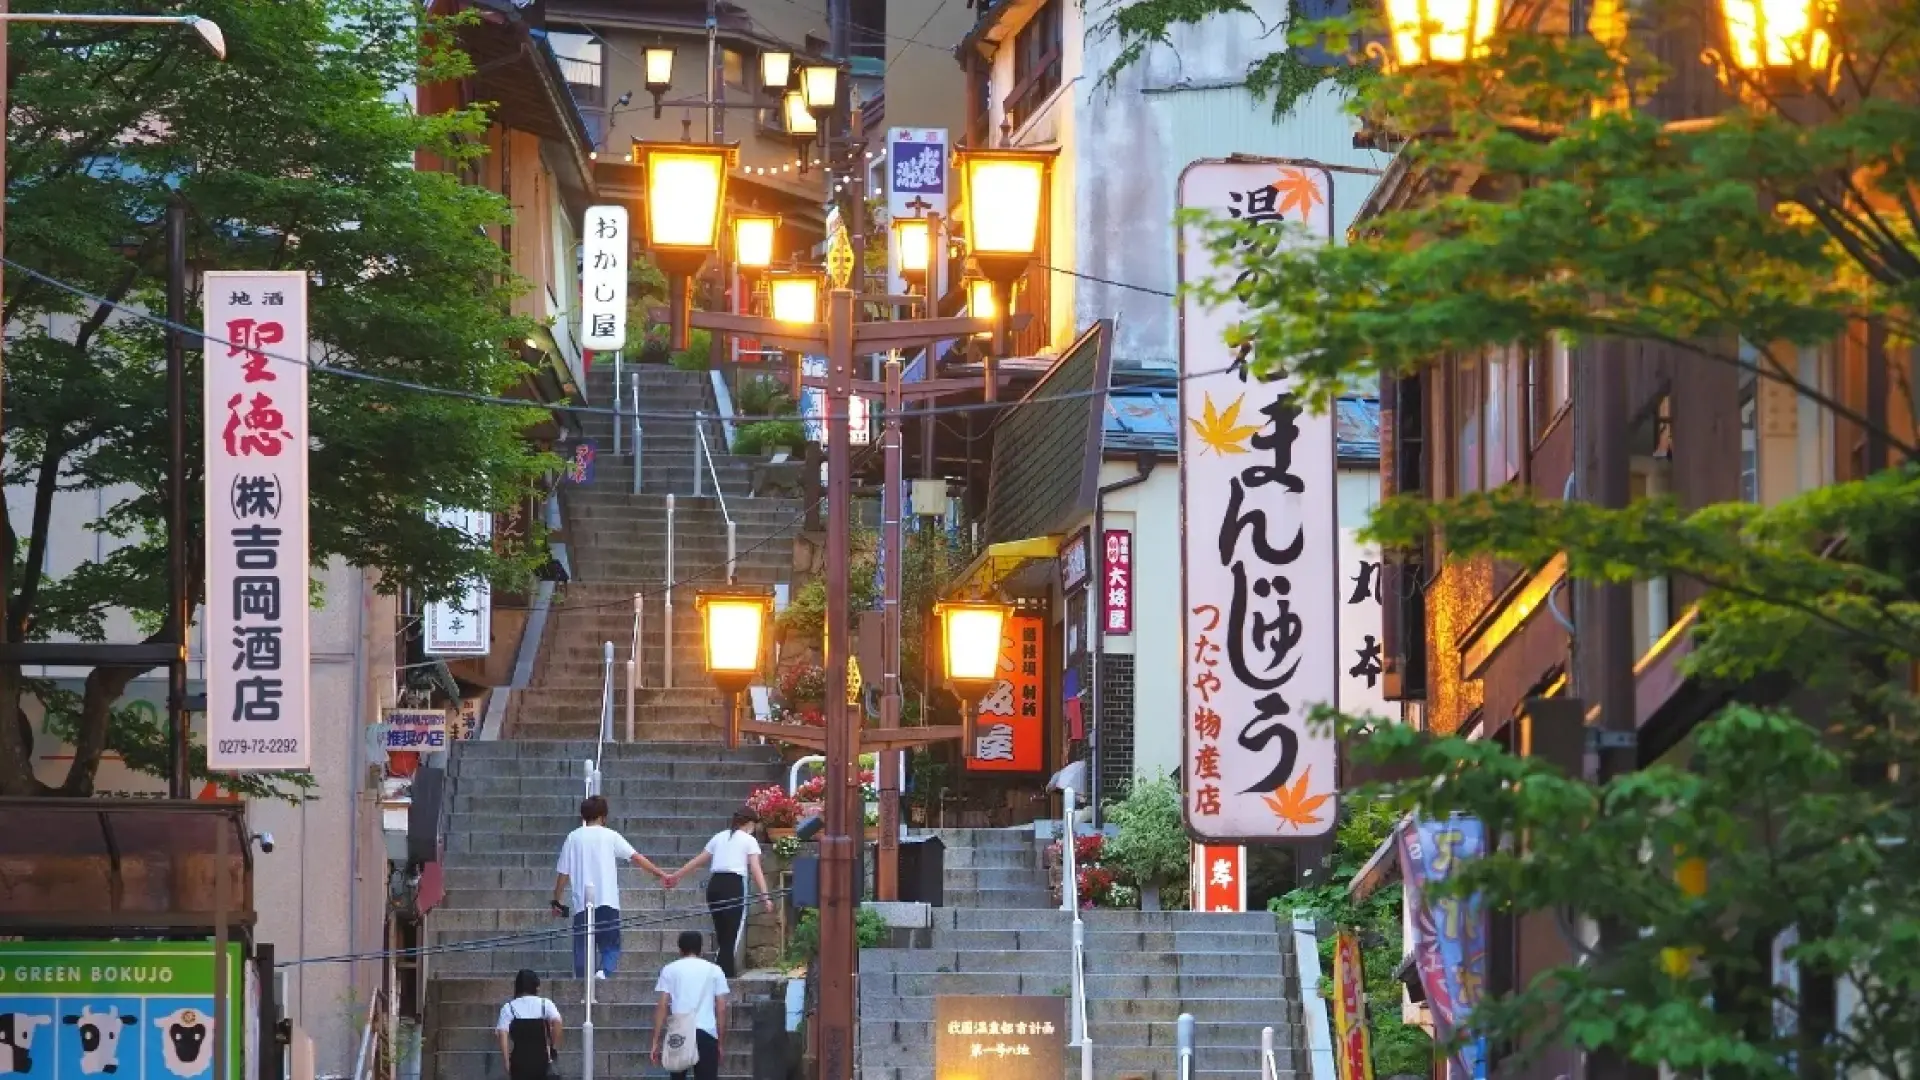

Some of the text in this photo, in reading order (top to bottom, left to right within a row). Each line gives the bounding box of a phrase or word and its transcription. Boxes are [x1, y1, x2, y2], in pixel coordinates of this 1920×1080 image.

[228, 291, 284, 306] 地酒
[1192, 604, 1222, 817] つたや物産店
[219, 739, 298, 755] 0279-72-2292
[15, 966, 81, 981] GREEN
[91, 966, 173, 982] BOKUJO
